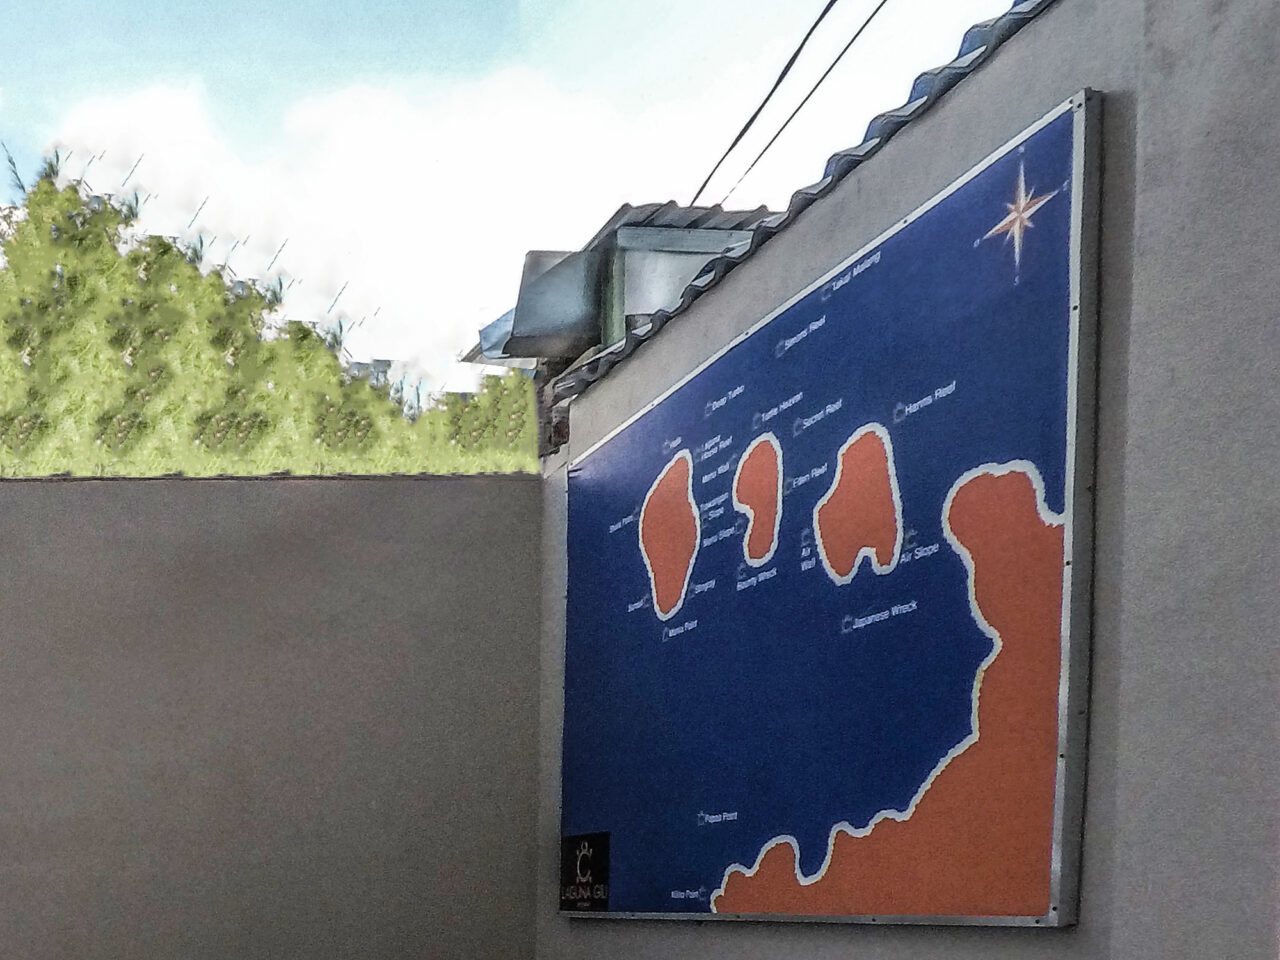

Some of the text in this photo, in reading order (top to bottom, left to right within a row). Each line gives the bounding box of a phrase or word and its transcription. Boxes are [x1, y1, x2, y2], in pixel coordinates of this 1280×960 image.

[934, 379, 956, 400] Reef
[825, 398, 842, 415] Reef
[811, 462, 828, 478] Reef
[899, 543, 940, 565] Air Slope
[891, 600, 919, 617] Wreck
